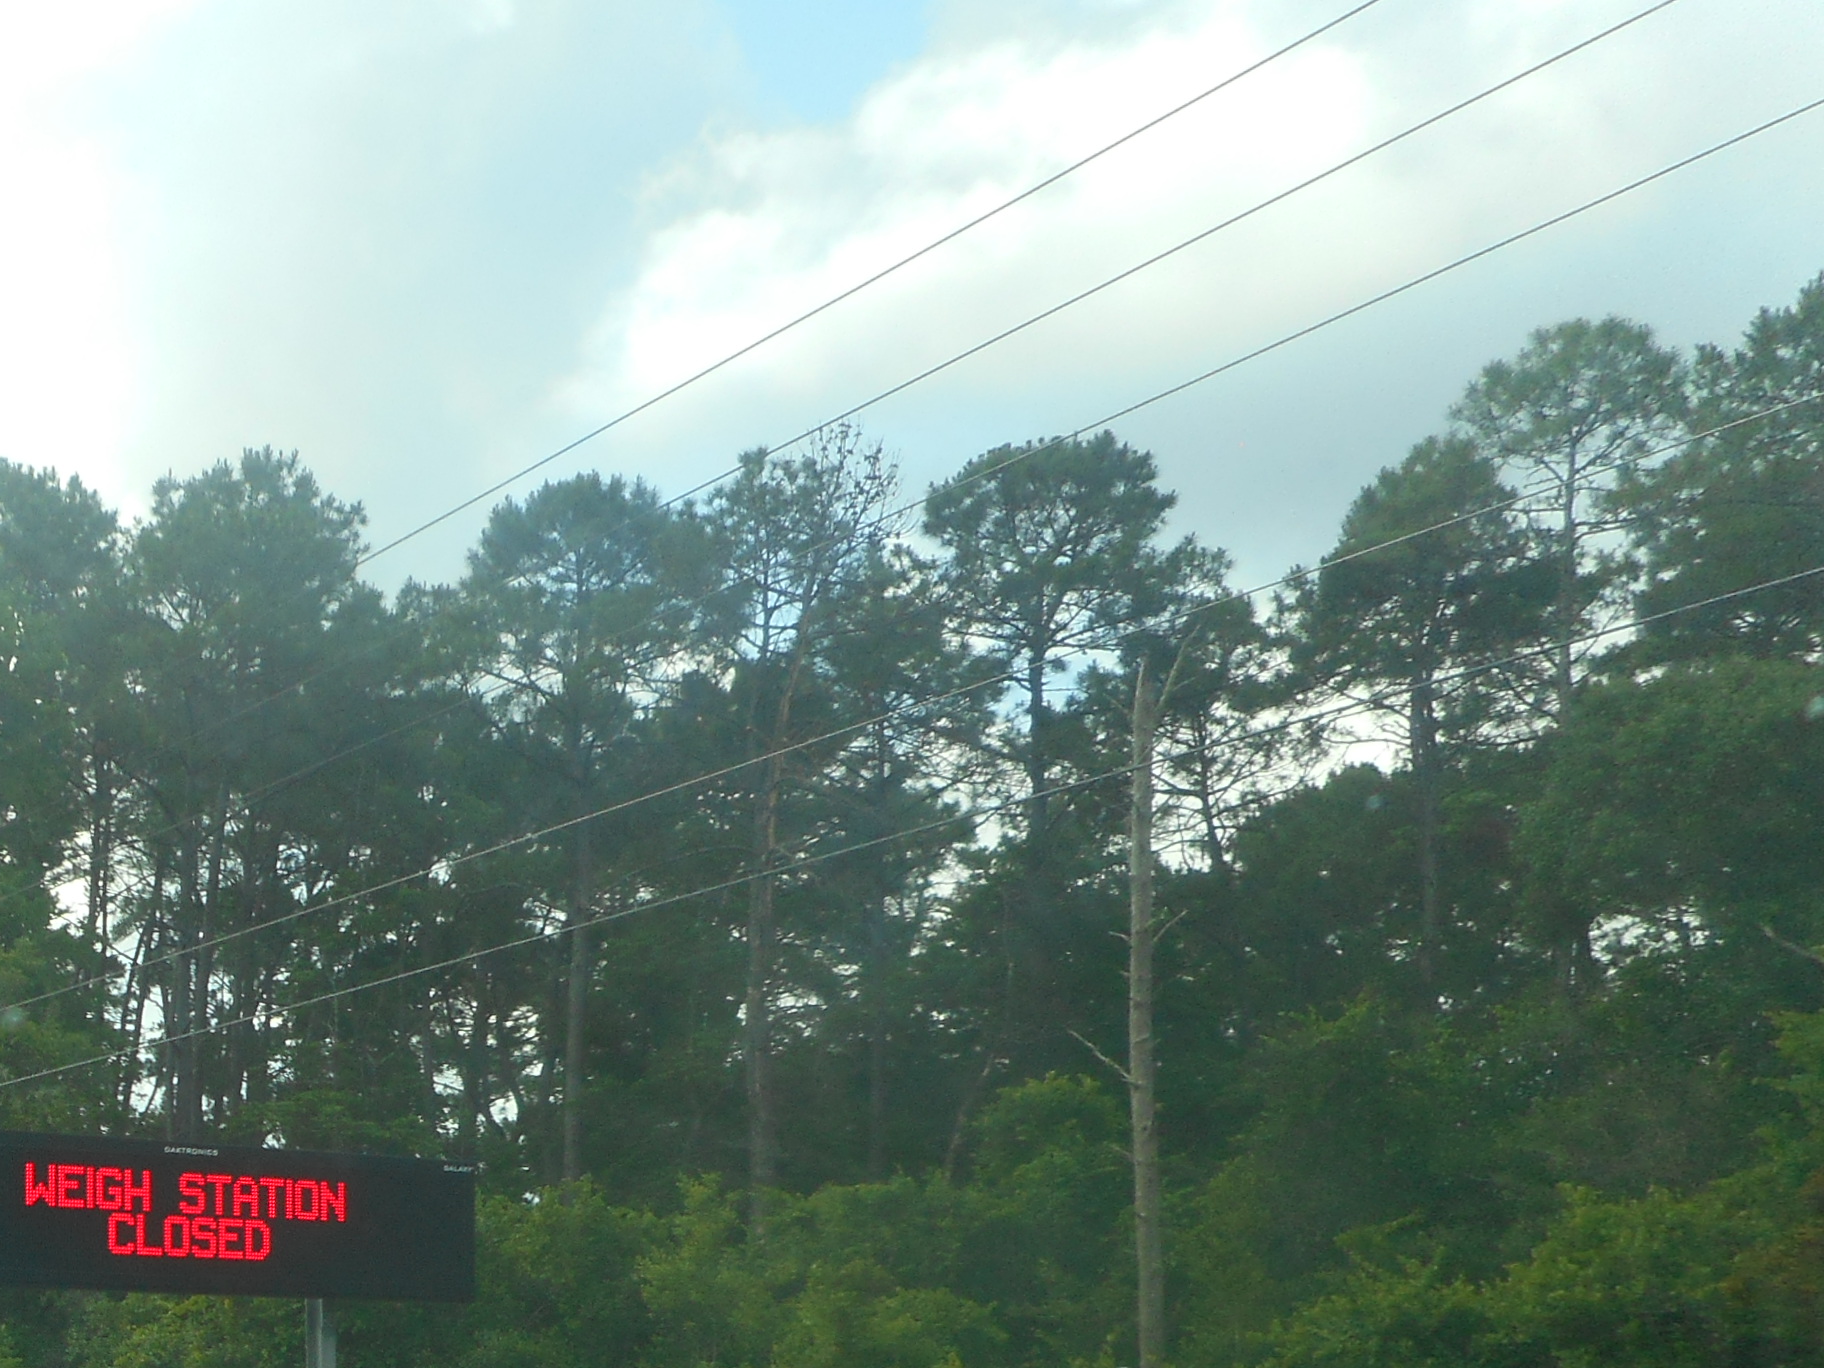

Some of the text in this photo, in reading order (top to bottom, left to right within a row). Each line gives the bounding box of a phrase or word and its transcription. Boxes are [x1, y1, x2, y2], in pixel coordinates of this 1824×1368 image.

[24, 1161, 348, 1223] WEIGH STATION
[107, 1212, 273, 1262] CLOSED
